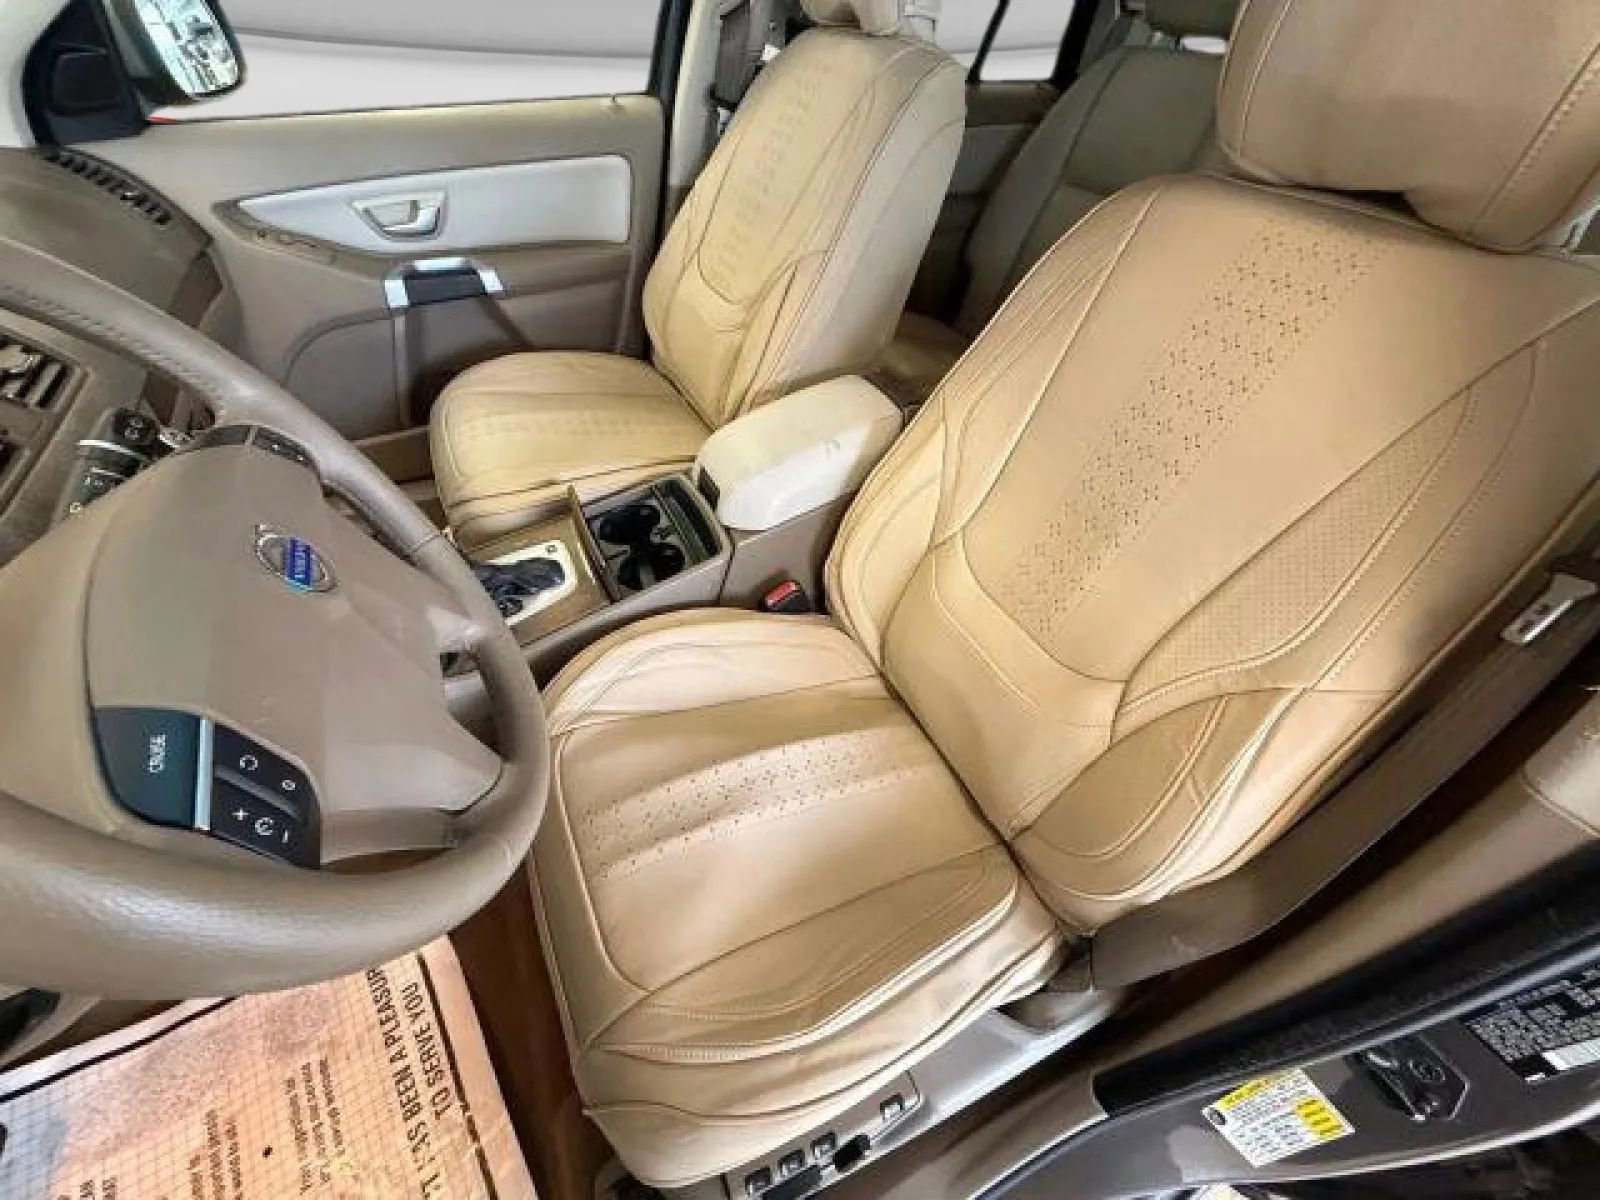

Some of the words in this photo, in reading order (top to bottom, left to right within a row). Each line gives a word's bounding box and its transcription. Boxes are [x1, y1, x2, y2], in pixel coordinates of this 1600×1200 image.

[401, 982, 426, 1021] YOU
[389, 1047, 408, 1064] A
[413, 1022, 443, 1087] SERVE
[393, 1065, 422, 1122] BEEN
[430, 1088, 453, 1120] TO
